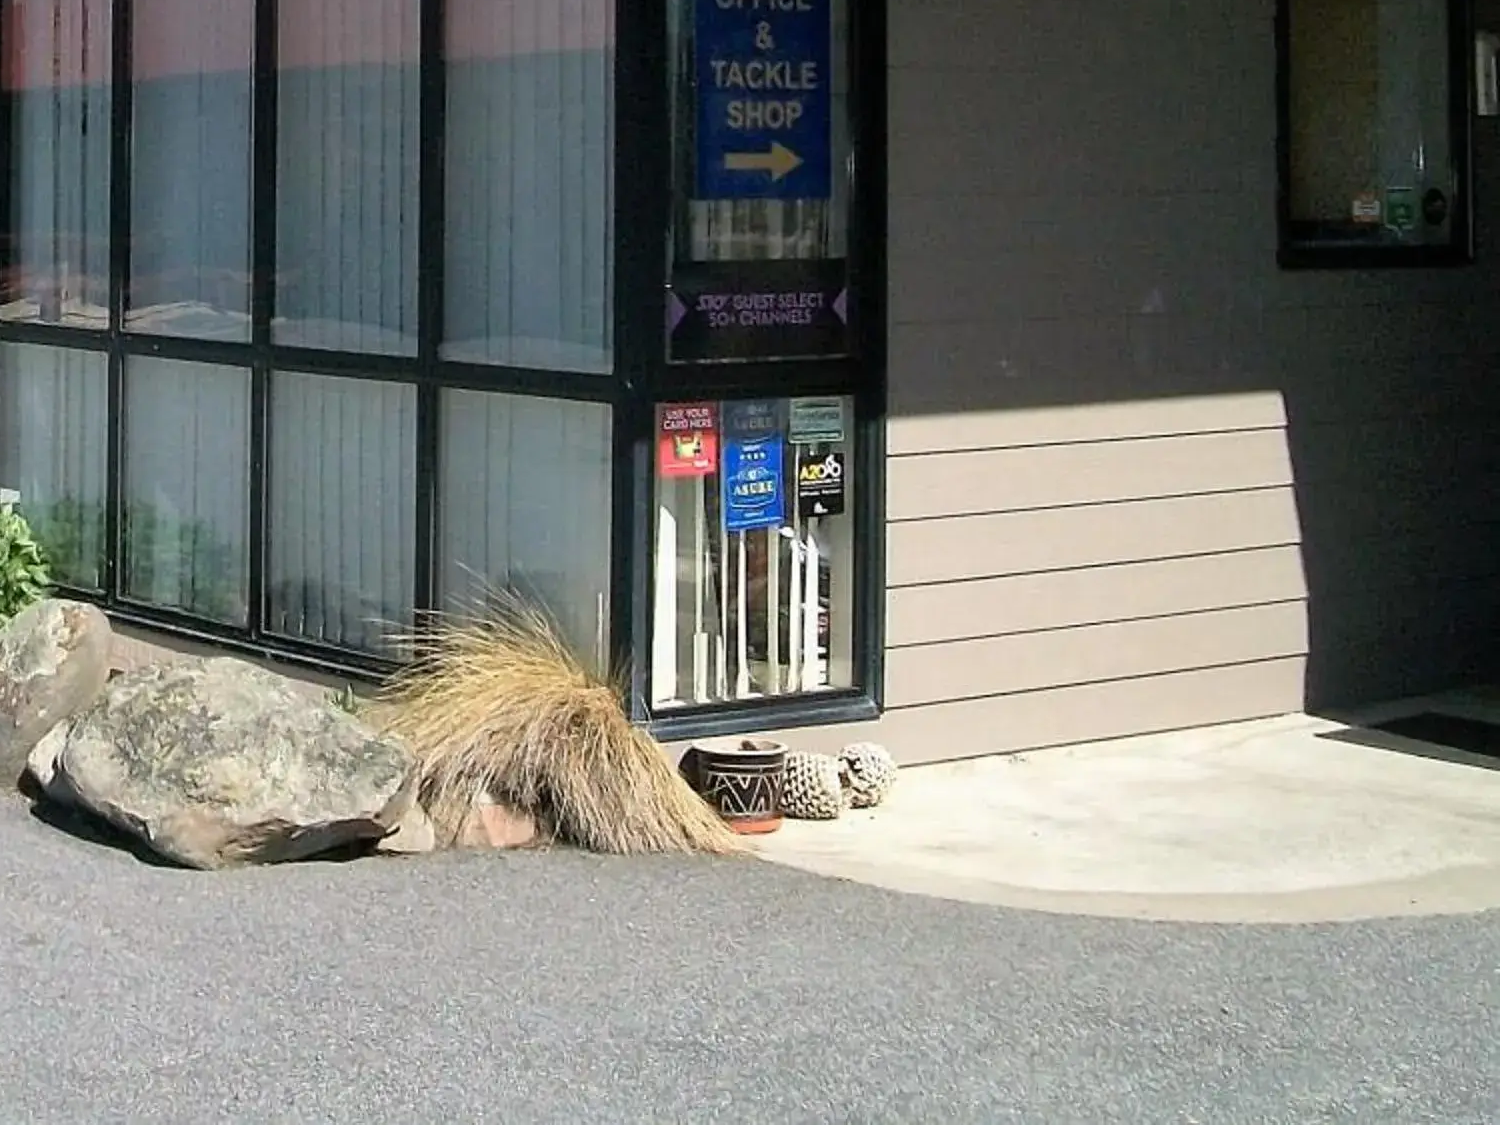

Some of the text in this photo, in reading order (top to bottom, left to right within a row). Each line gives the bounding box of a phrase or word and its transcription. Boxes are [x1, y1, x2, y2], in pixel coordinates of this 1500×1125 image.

[755, 20, 775, 50] &
[710, 59, 818, 90] TACKLE
[726, 99, 804, 130] SHOP
[732, 293, 777, 310] GUEST
[778, 292, 823, 308] SELECT
[739, 308, 812, 326] CHANNELS
